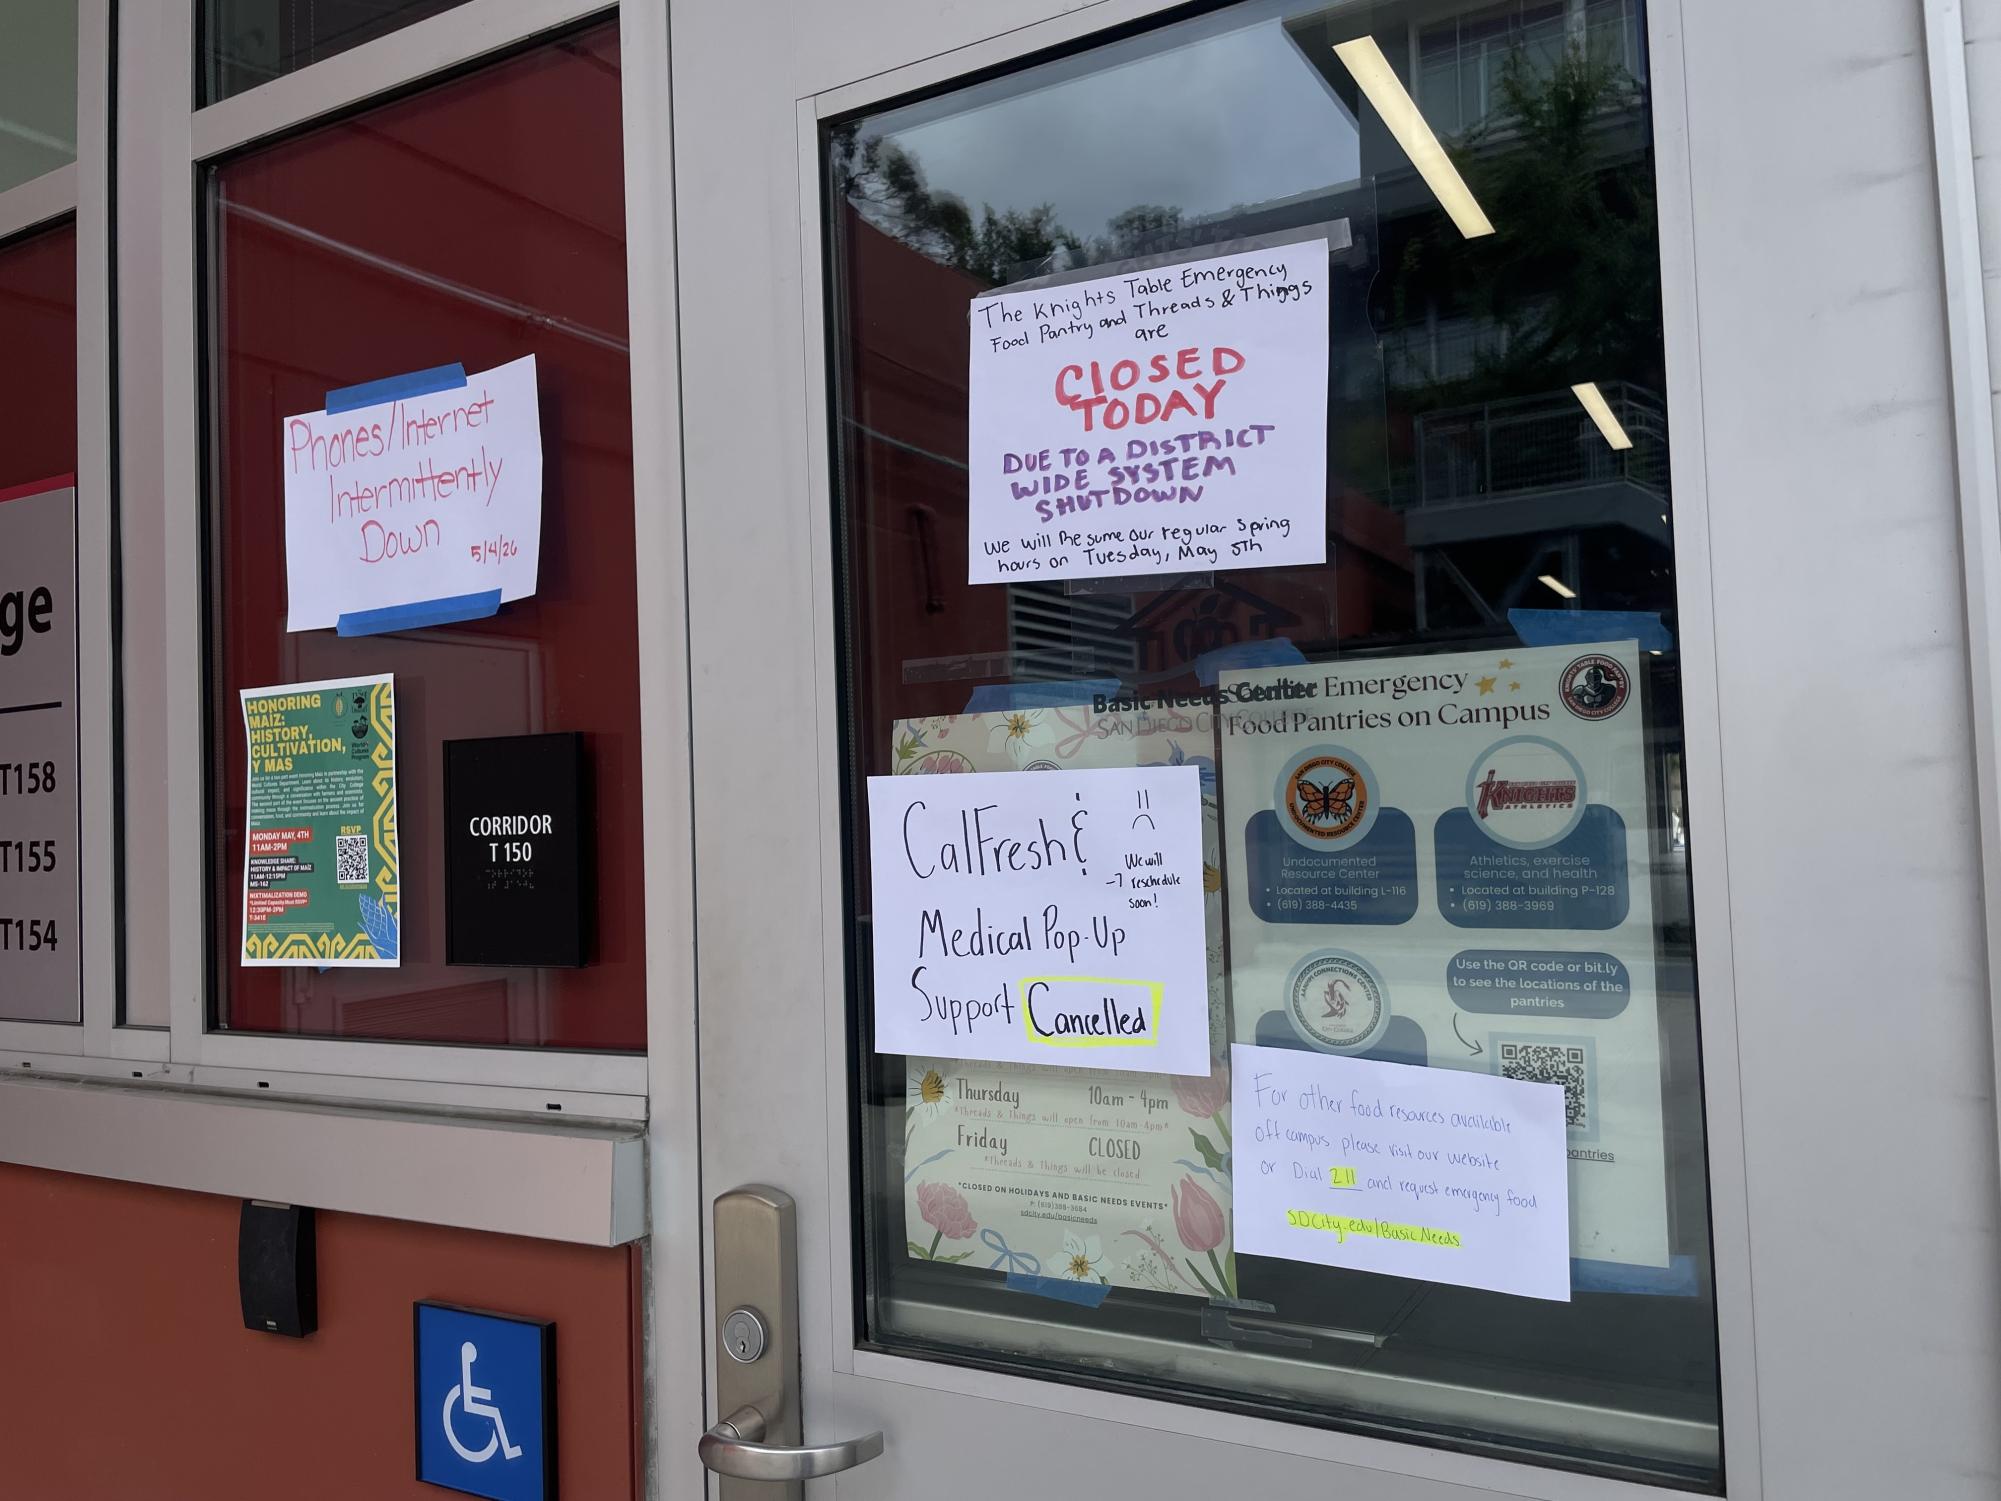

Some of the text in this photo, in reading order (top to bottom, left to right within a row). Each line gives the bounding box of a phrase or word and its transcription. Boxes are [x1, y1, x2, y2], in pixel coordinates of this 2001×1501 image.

[978, 263, 1288, 329] The Knights Table Emergency
[990, 331, 1029, 353] Food
[1039, 321, 1094, 344] Pantry
[1099, 311, 1127, 328] and
[1133, 295, 1216, 320] Threads
[1221, 289, 1235, 308] &
[1134, 322, 1169, 341] are
[1067, 379, 1226, 432] TODAY
[289, 389, 494, 474] Phones/Internet
[1003, 424, 1276, 475] DUE TO A DISTRICT
[329, 444, 503, 524] Intermittently
[1010, 456, 1236, 501] WIDE SYSTEM
[359, 518, 440, 563] Down
[984, 539, 1010, 557] We
[1021, 533, 1052, 550] will
[1161, 518, 1227, 544] regular
[1237, 516, 1292, 537] Spring
[470, 534, 518, 565] 5/4/26
[997, 552, 1040, 573] hours
[1049, 553, 1068, 569] on
[1083, 543, 1169, 567] Tuesday,
[1178, 542, 1218, 563] May
[0, 585, 53, 656] ge
[1324, 670, 1469, 699] Emergency
[246, 693, 321, 714] HONORING
[1229, 708, 1288, 736] Food
[1293, 706, 1392, 732] Pantries
[1398, 709, 1431, 728] on
[1438, 702, 1551, 728] Campus
[251, 724, 313, 744] HISTORY,
[251, 737, 346, 759] CULTIVATION,
[252, 757, 293, 774] Y MAS
[0, 760, 56, 796] T158
[252, 830, 309, 841] MONDAY MAY, 4TH
[340, 825, 362, 834] RSVP
[469, 814, 552, 836] CORRIDOR
[252, 843, 288, 852] 11AM-2PM
[903, 800, 1067, 879] CalFresh
[0, 839, 56, 874] T155
[489, 842, 532, 862] T 150
[1124, 851, 1164, 868] We will
[1282, 856, 1377, 868] Undocumented
[1469, 854, 1591, 868] Athletics, exercise
[1130, 873, 1181, 889] reschedule
[1281, 868, 1381, 880] Resource Center
[1463, 867, 1598, 881] science, and health
[1128, 893, 1159, 909] soon!
[1276, 885, 1407, 898] Located at building L-116
[1461, 885, 1616, 898] Located at building P-128
[1277, 899, 1358, 911] (619) 388-4435
[1463, 900, 1492, 912] (619)
[0, 917, 58, 952] T154
[919, 907, 1032, 959] Medical
[1042, 904, 1126, 963] Pop-Up
[1455, 959, 1618, 976] Use the QR code or bit.ly
[1453, 976, 1624, 992] to see the locations of the
[911, 966, 1147, 1037] Support Cancelled
[1510, 995, 1565, 1009] pantries
[956, 1077, 1169, 1115] Thursday 10am 4pm
[1252, 1072, 1288, 1109] For
[1299, 1083, 1343, 1114] other
[1350, 1089, 1384, 1119] food
[1450, 1113, 1512, 1134] available
[1008, 1107, 1036, 1122] Things
[1042, 1111, 1058, 1123] will
[1064, 1116, 1084, 1127] open
[1089, 1115, 1109, 1127] from
[957, 1124, 1141, 1161] Friday CLOSED
[1254, 1118, 1280, 1143] off
[1285, 1127, 1330, 1152] campus
[1341, 1132, 1381, 1161] please
[1417, 1148, 1440, 1161] our
[1448, 1151, 1500, 1171] website
[1040, 1158, 1069, 1174] Things
[1074, 1164, 1092, 1175] will
[1097, 1165, 1108, 1176] be
[1113, 1167, 1141, 1180] closed
[994, 1184, 1007, 1194] ON
[1008, 1186, 1050, 1198] HOLIDAYS
[1052, 1191, 1070, 1201] AND
[1072, 1192, 1098, 1203] BASIC
[1100, 1195, 1128, 1207] NEEDS
[1292, 1161, 1323, 1182] Dial
[1329, 1168, 1357, 1185] 211
[1367, 1175, 1393, 1191] and
[1399, 1179, 1439, 1200] request
[1444, 1184, 1500, 1217] emergency
[1507, 1188, 1537, 1208] food
